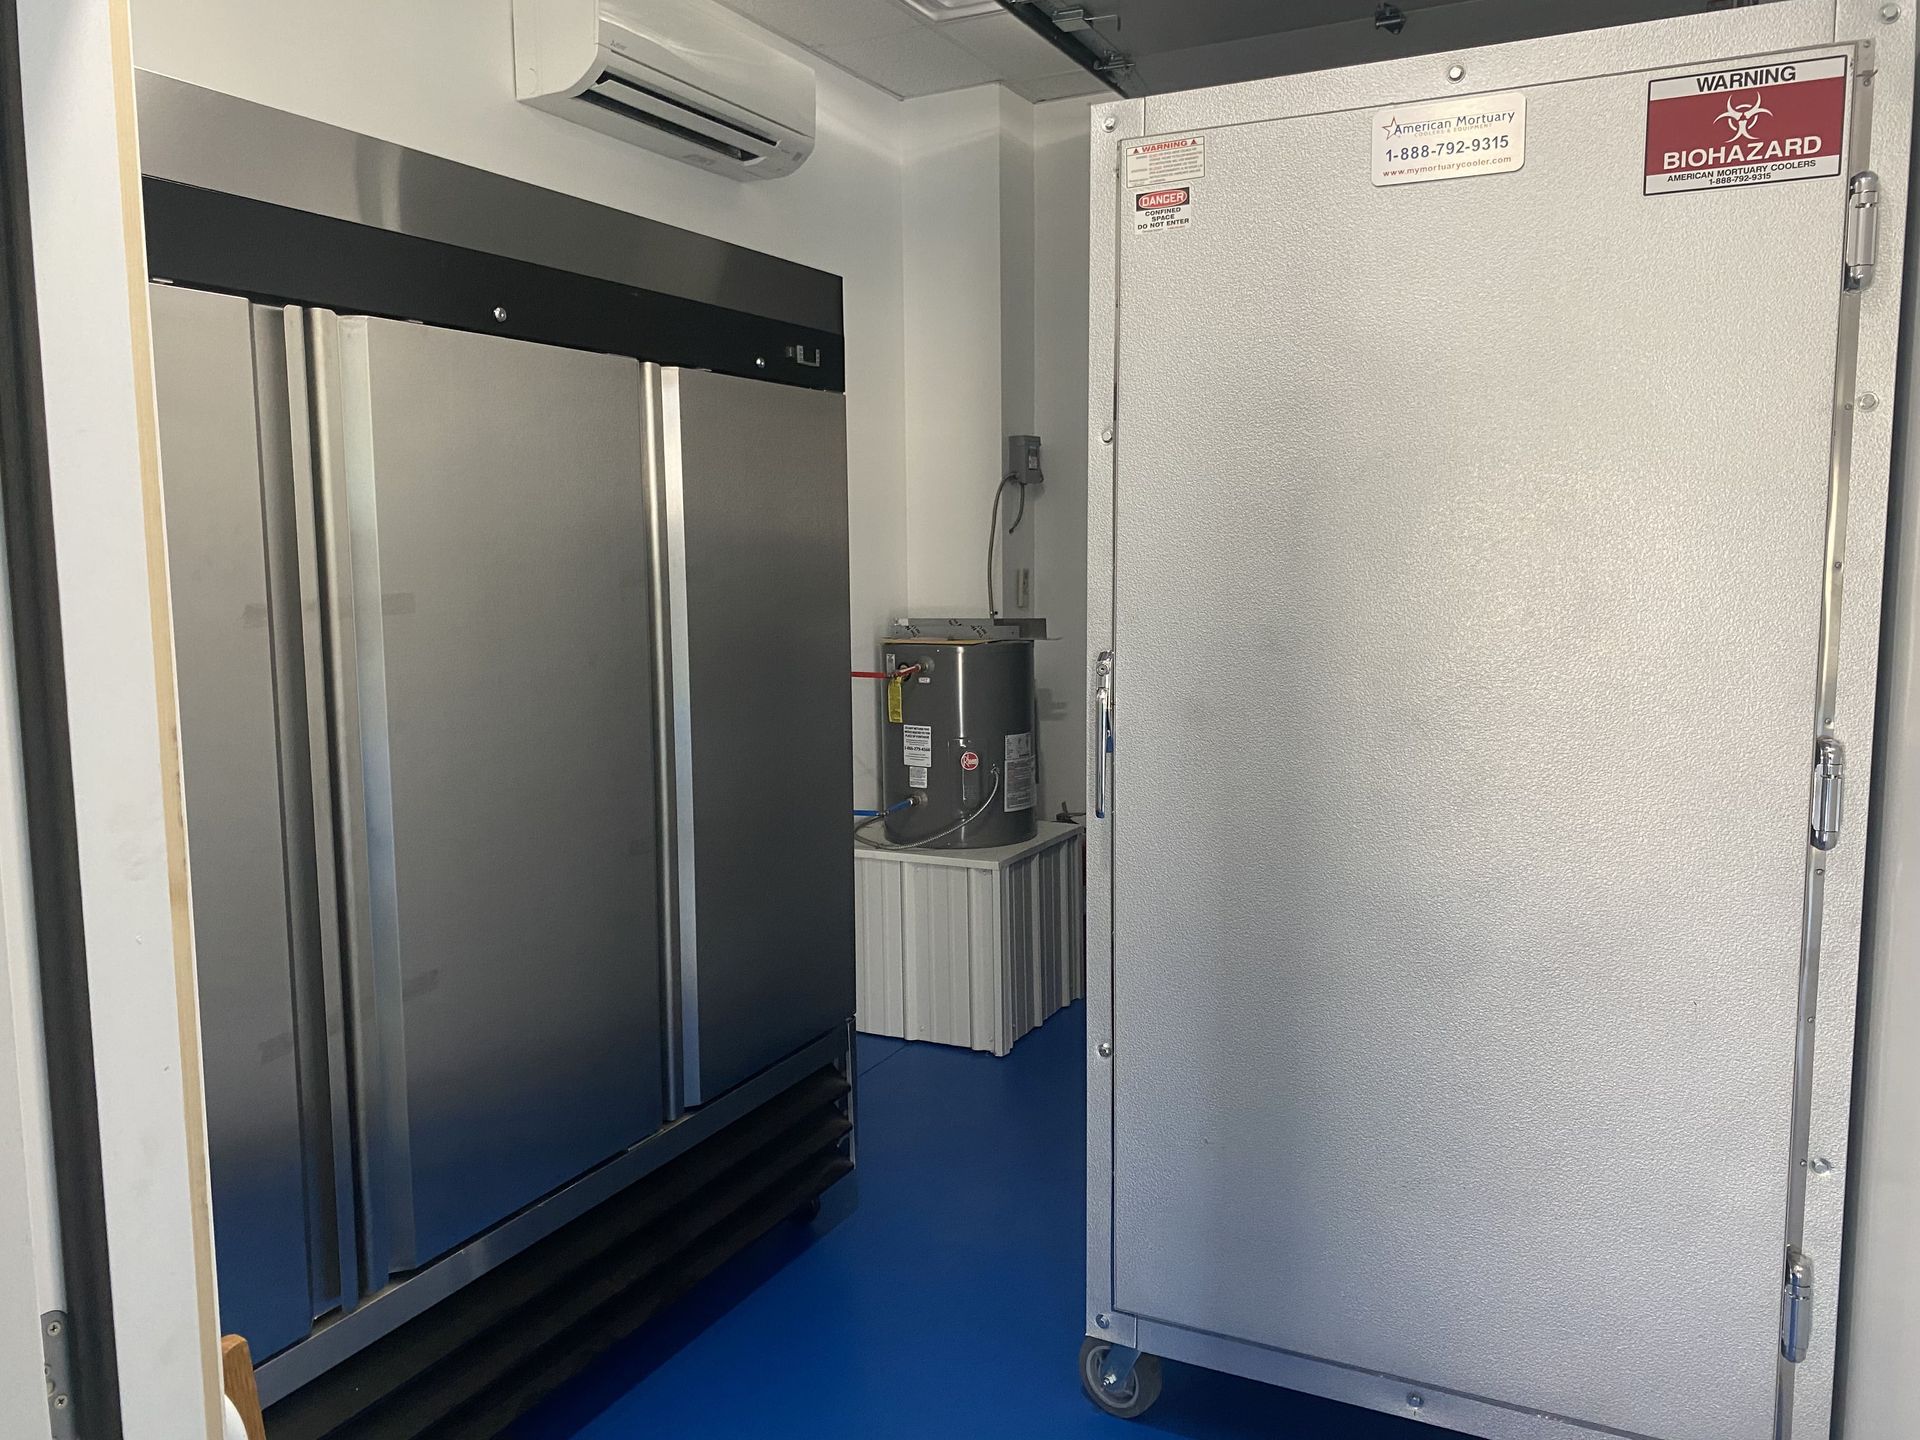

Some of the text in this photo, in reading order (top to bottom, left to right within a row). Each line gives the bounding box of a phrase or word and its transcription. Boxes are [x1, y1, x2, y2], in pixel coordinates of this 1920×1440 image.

[1696, 65, 1796, 93] WARNING
[1394, 111, 1515, 136] American Mortuary
[1453, 123, 1492, 132] EQUIPMENT
[1142, 140, 1188, 153] WARNING
[1385, 135, 1509, 162] 1-888-792-9315
[1663, 135, 1822, 170] BIOHAZARD
[1382, 156, 1512, 177] www.mymortuarycooler.com
[1667, 160, 1816, 183] AMERICAN MORTUARY COOLERS
[1709, 172, 1771, 185] 1-888-792-9315
[1142, 192, 1184, 207] DANGER
[1145, 207, 1181, 217] CONFINED
[1151, 214, 1175, 222] SPACE
[1166, 218, 1189, 226] ENTER
